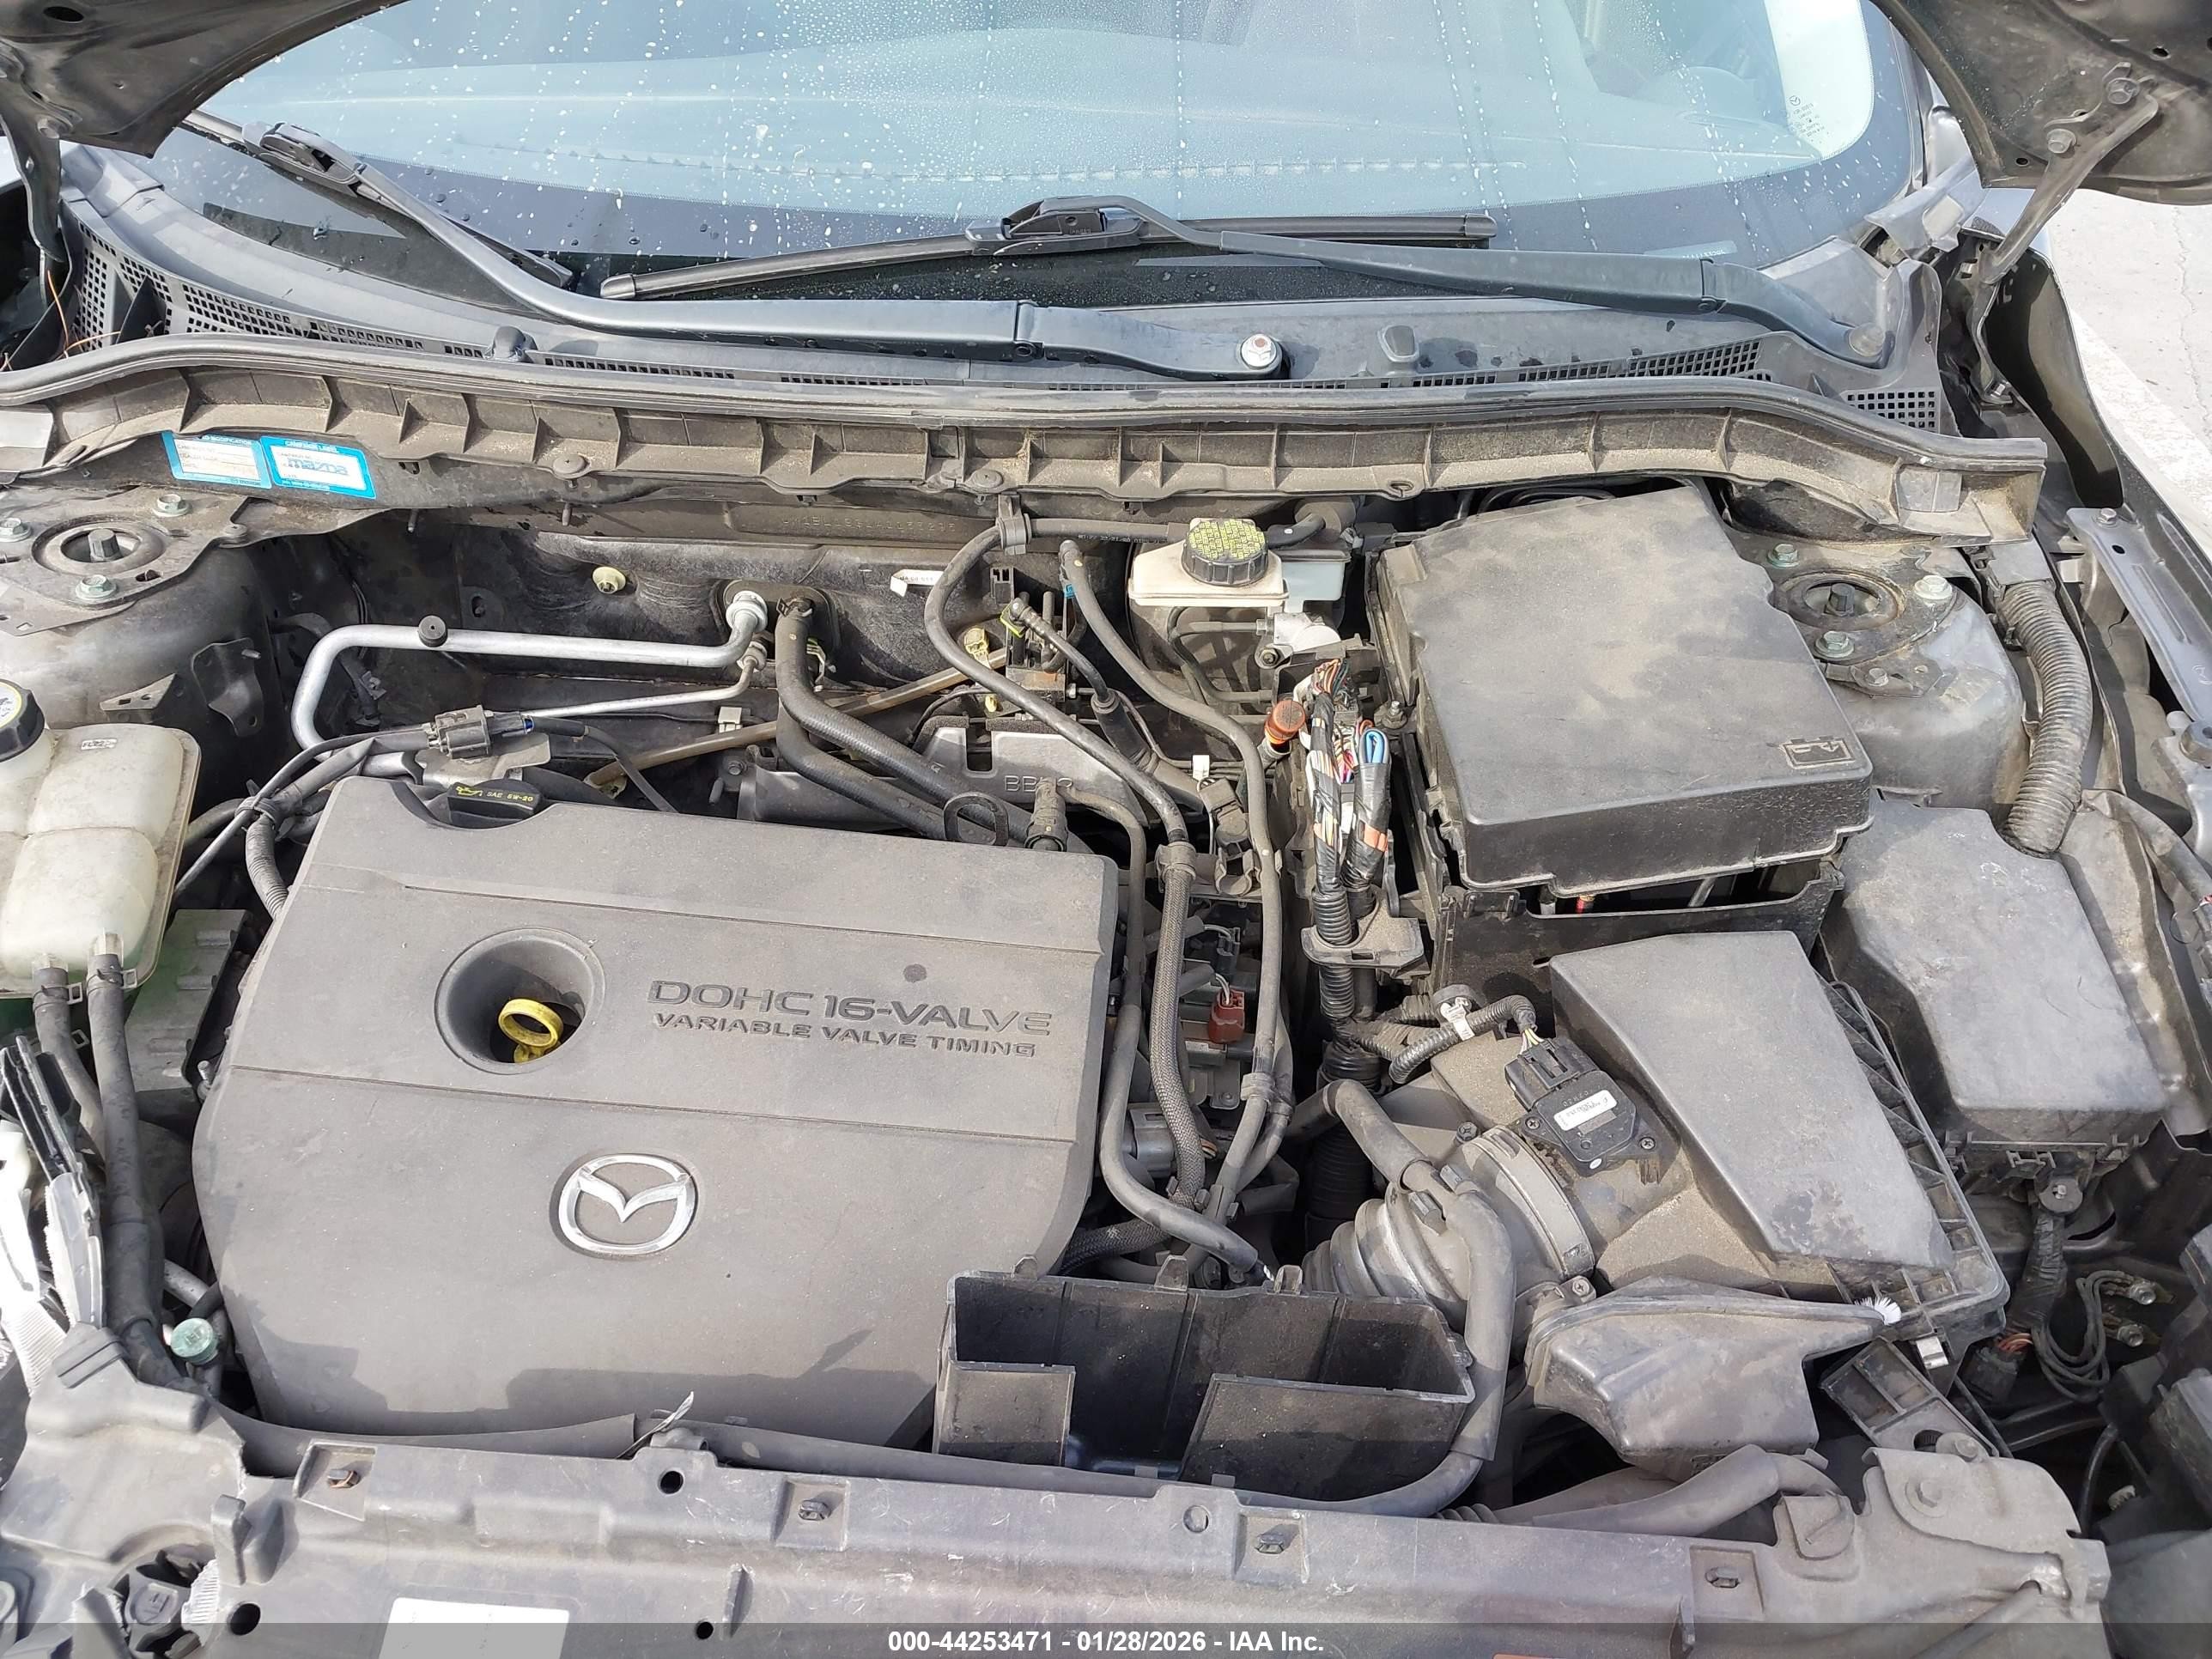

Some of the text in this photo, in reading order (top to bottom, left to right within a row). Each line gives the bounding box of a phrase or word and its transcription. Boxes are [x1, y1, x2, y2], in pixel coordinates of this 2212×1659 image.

[507, 793, 534, 802] 5W-20
[646, 979, 1053, 1036] DOHC 16-VALVE
[654, 1012, 1036, 1058] VARIABLE VALVE TIMING
